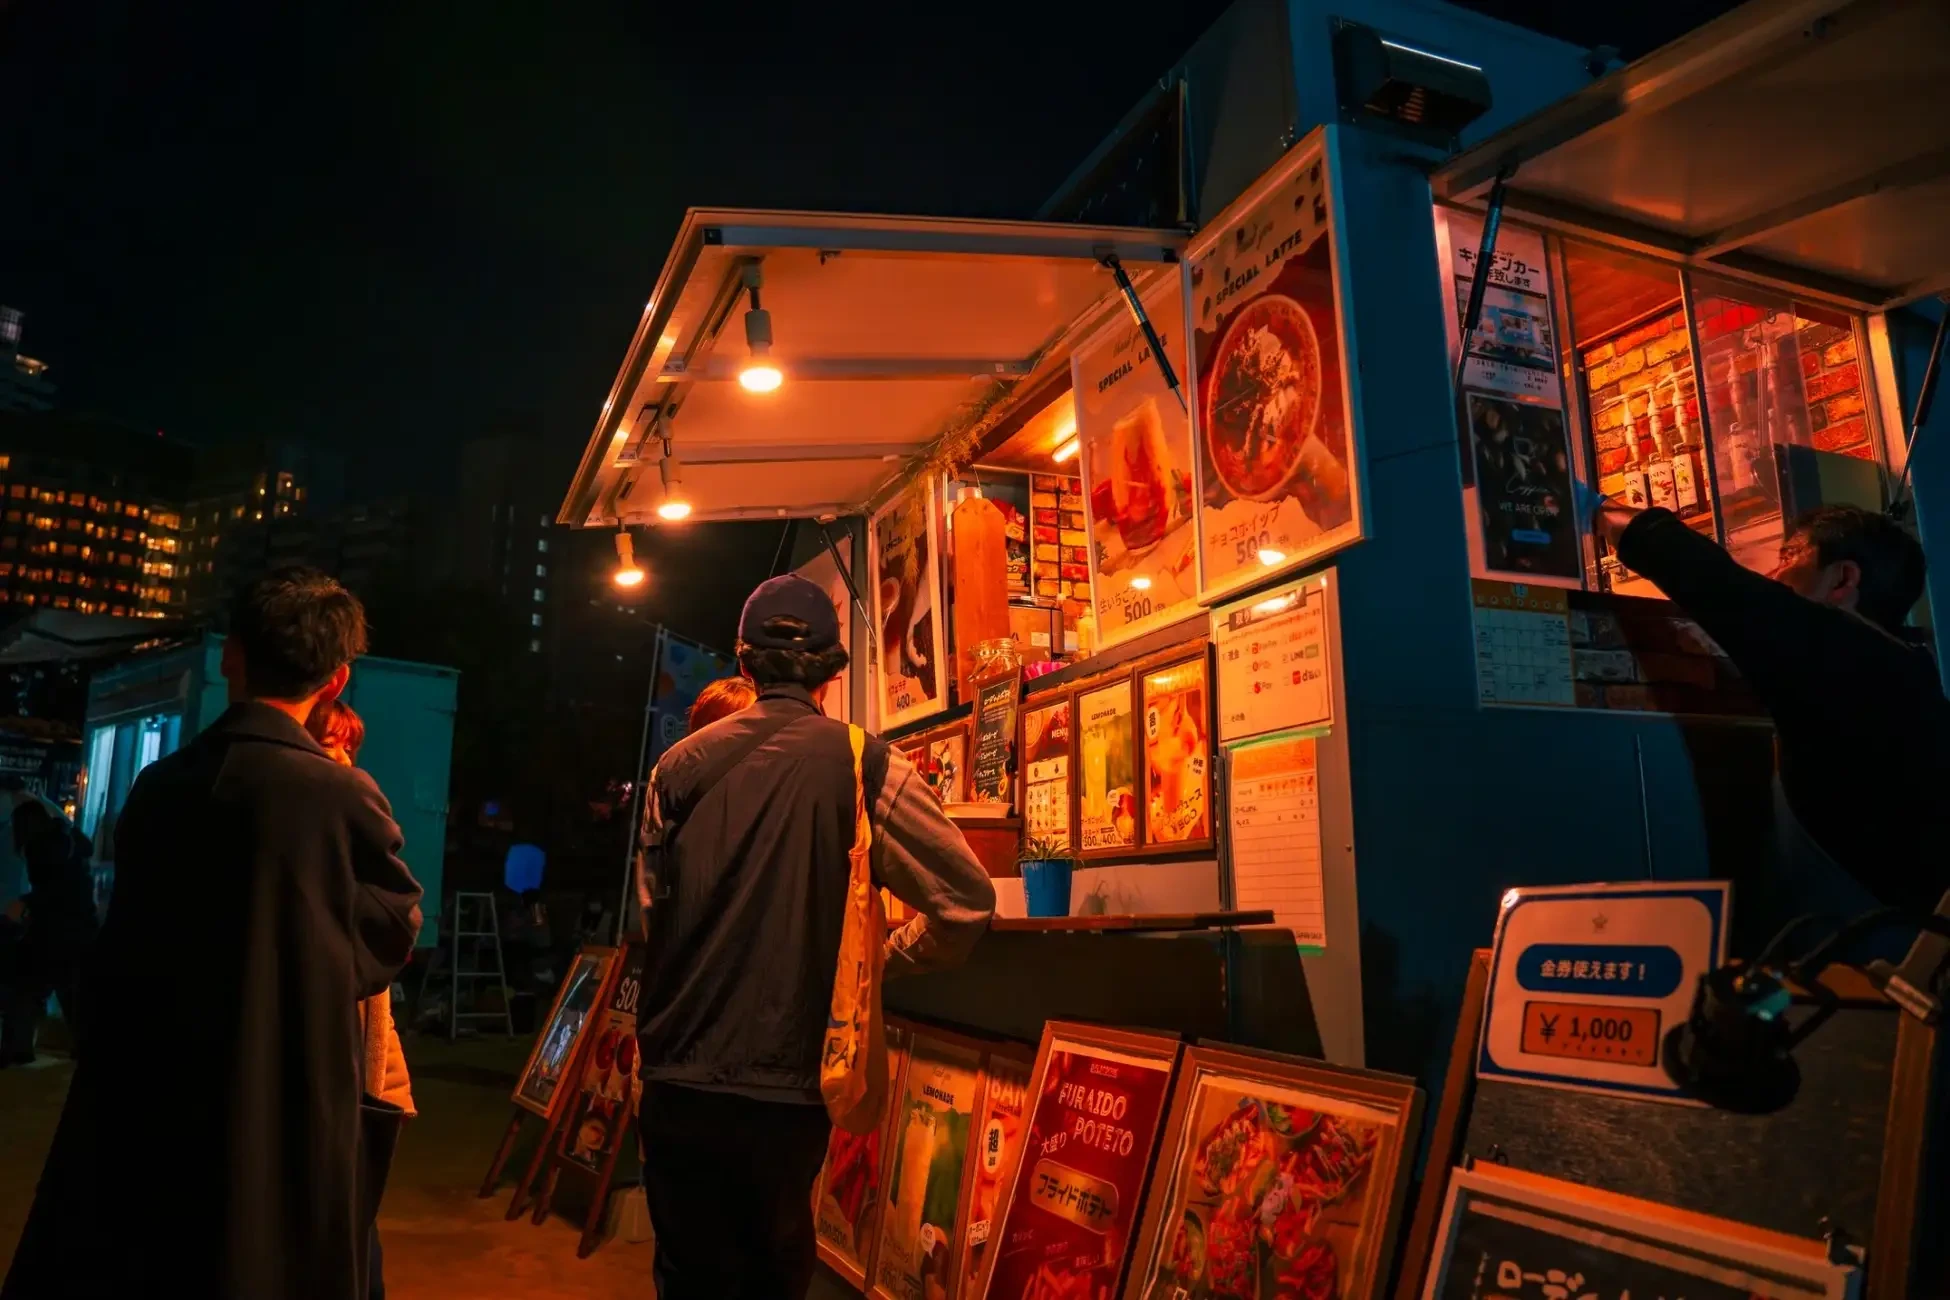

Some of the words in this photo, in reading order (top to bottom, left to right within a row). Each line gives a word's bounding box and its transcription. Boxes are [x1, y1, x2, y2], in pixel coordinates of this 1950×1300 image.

[1216, 263, 1260, 305] SPECIAL
[1265, 228, 1302, 268] LATTE
[1098, 360, 1133, 393] SPECIAL
[1138, 332, 1167, 365] LAE
[1500, 502, 1514, 512] WE
[1515, 503, 1532, 514] ARE
[1124, 597, 1152, 625] 500
[1091, 708, 1117, 721] LEMONADE
[1052, 727, 1069, 739] MENU
[923, 1084, 955, 1106] LEMONADE
[1058, 1082, 1128, 1121] FURAIDO
[1040, 1131, 1068, 1157] 大盛り
[1073, 1116, 1135, 1157] POTETO
[1036, 1173, 1113, 1219] フライドポテト
